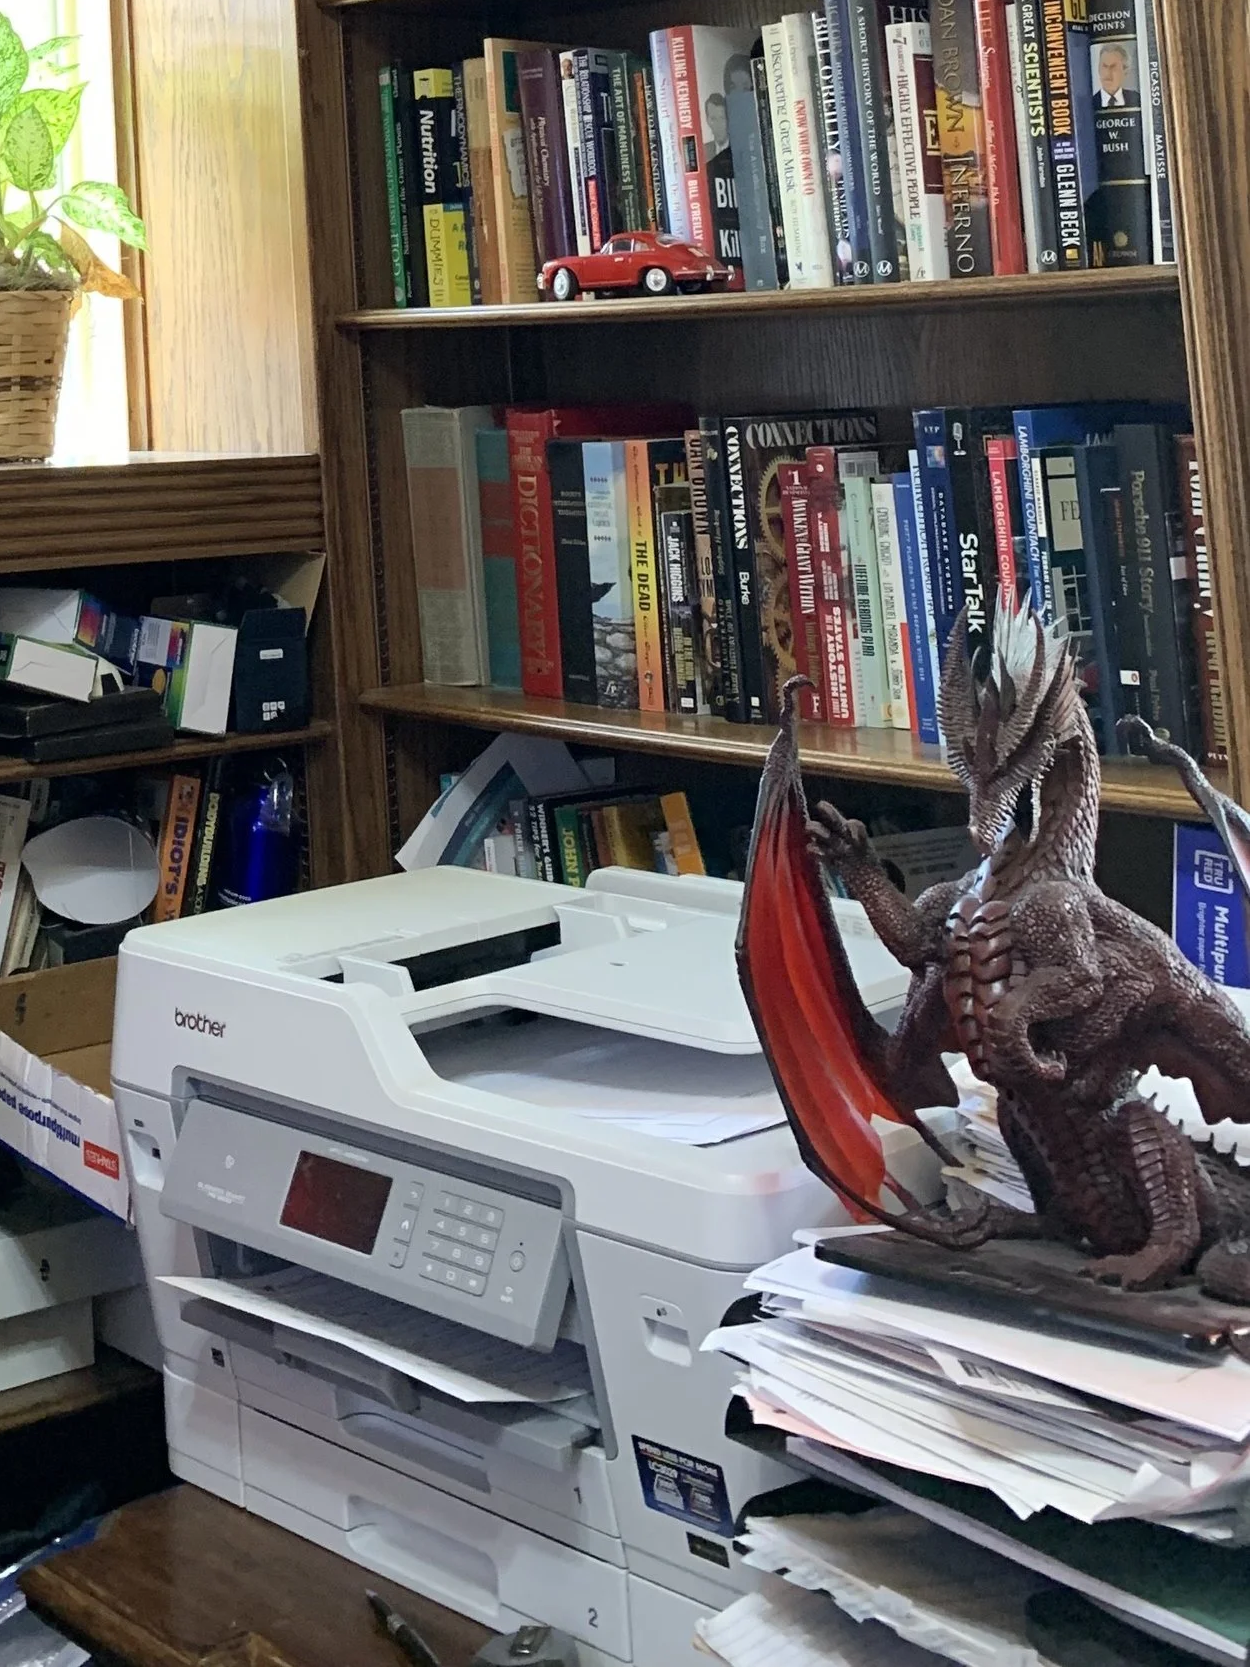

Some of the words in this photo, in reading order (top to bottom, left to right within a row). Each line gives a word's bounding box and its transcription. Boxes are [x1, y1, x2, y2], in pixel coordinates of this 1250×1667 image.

[814, 17, 832, 61] BILL
[1021, 4, 1035, 38] GREAT
[1092, 20, 1126, 32] POINTS
[672, 37, 686, 78] KILLING
[1044, 1, 1069, 95] INCONVENIENT
[612, 68, 622, 87] THE
[614, 88, 625, 108] ART
[770, 43, 787, 115] Discovering
[896, 75, 912, 114] HIGHLY
[940, 46, 965, 134] BROWN
[1023, 42, 1045, 136] SCIENTISTS
[1149, 61, 1161, 106] PICASSO
[616, 110, 627, 124] OF
[676, 81, 692, 129] KENNEDY
[819, 66, 841, 151] O'REILLY
[1052, 99, 1072, 135] BOOK
[1096, 117, 1136, 129] GEORGE
[420, 110, 438, 194] Nutrition
[617, 125, 632, 183] MANLINESS
[778, 119, 794, 155] Great
[900, 117, 916, 176] EFFECTIVE
[1102, 141, 1129, 153] BUSH
[1154, 134, 1166, 178] MATISSE
[687, 180, 699, 201] BILL
[783, 159, 797, 193] Music
[1056, 164, 1079, 207] GLENN
[690, 202, 703, 240] O'REILLY
[906, 179, 921, 220] PEOPLE
[943, 156, 975, 273] INFERNO
[1060, 211, 1081, 247] BECK
[429, 219, 445, 285] DUMMIES
[1016, 426, 1033, 501] LAMBORGHINI
[725, 426, 749, 549] CONNECTIONS
[1130, 470, 1149, 535] Porsche
[937, 493, 952, 551] DATABASE
[1024, 503, 1041, 562] COUNTACH
[516, 475, 548, 658] DICTIONARY
[635, 541, 649, 569] THE
[667, 536, 683, 562] JACK
[1135, 537, 1152, 562] 911
[636, 573, 651, 612] DEAD
[668, 563, 685, 603] HIGGINS
[738, 572, 751, 605] Burke
[943, 557, 954, 610] SYSTEMS
[957, 533, 986, 634] StarTalk
[1138, 565, 1156, 614] Story
[832, 606, 844, 661] STATES
[839, 667, 850, 719] UNITED
[165, 816, 190, 895] IDIOT'S
[196, 792, 220, 885] BODYBUILDING
[562, 828, 579, 874] JOHN
[1203, 857, 1213, 884] RED
[1213, 861, 1224, 887] TRU
[1210, 905, 1230, 984] Multipur
[175, 1007, 227, 1038] brother
[19, 1102, 81, 1148] multipurpose
[587, 1607, 599, 1627] 2
